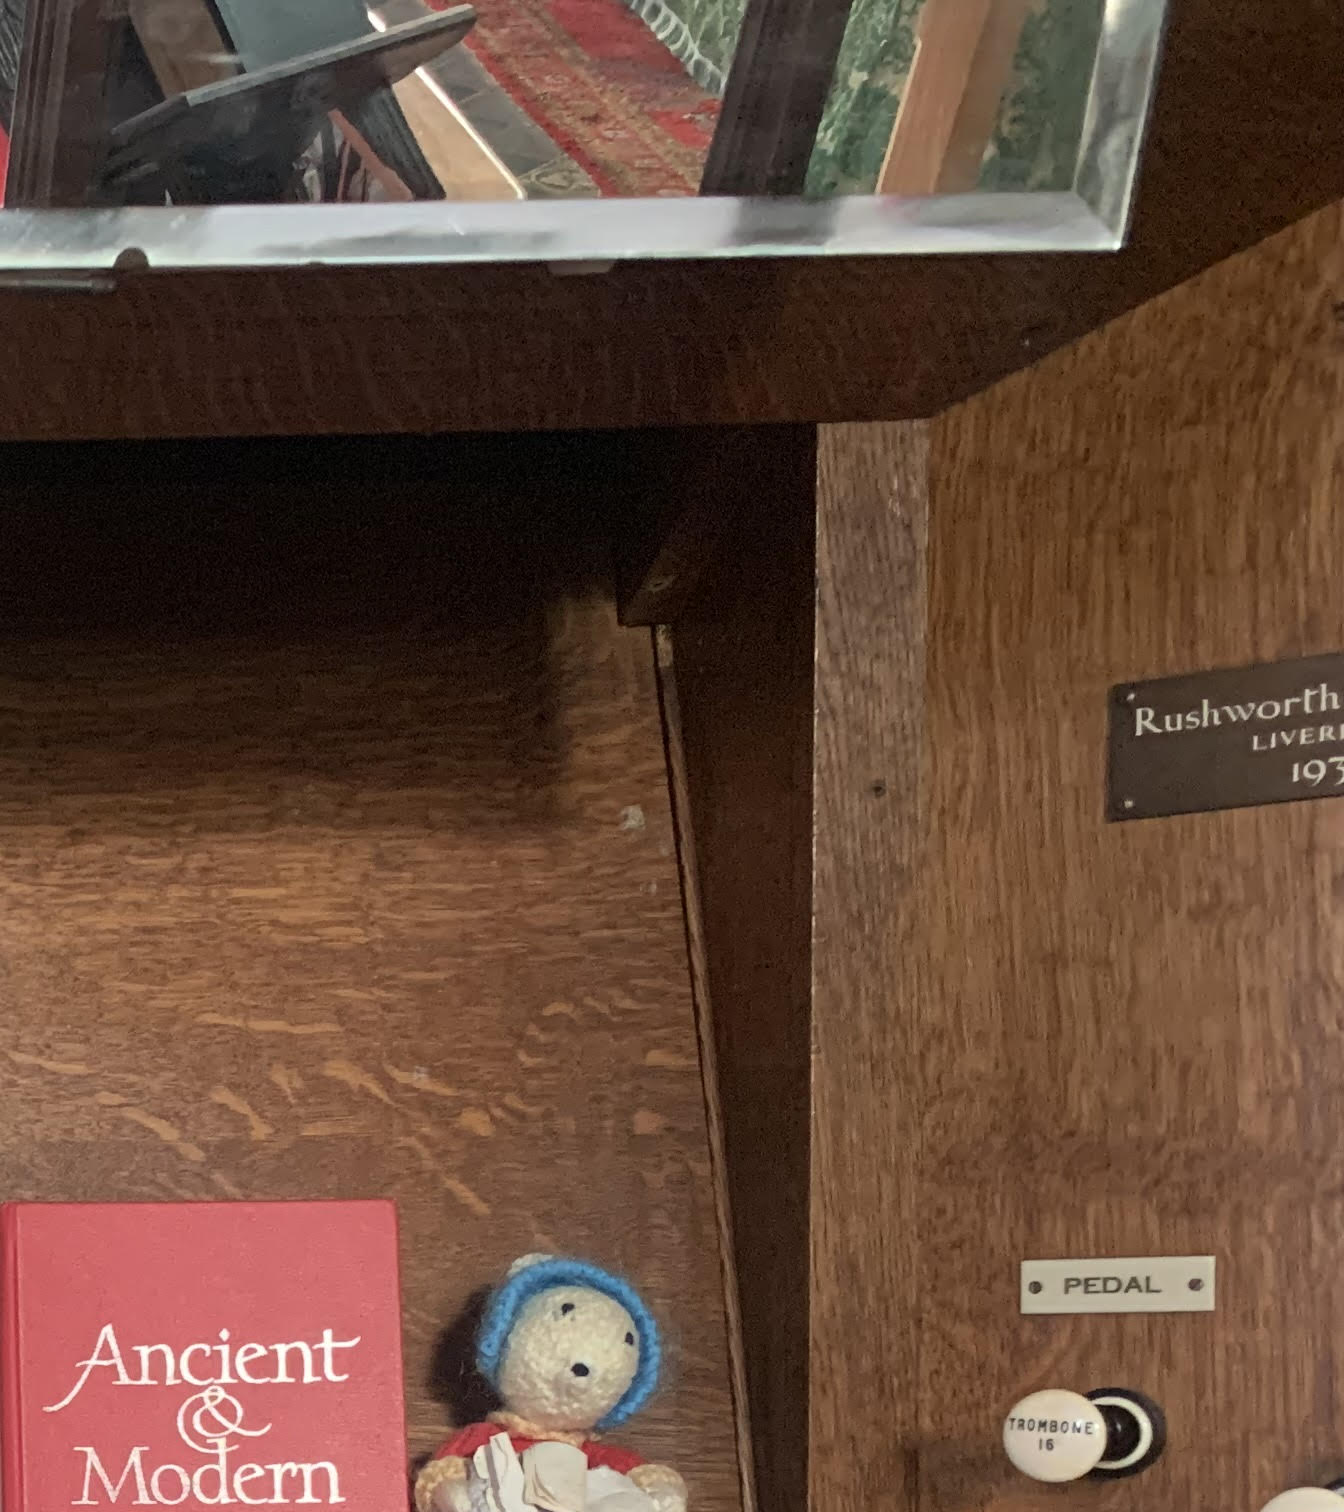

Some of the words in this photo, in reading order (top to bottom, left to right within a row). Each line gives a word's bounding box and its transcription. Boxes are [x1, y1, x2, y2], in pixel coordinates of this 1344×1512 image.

[1135, 683, 1341, 737] Rushworth
[1252, 724, 1344, 751] LIVER
[1063, 1275, 1162, 1295] PEDAL
[42, 1323, 362, 1413] Ancient
[176, 1385, 273, 1454] &
[1008, 1417, 1094, 1436] TROMBONE
[1038, 1438, 1055, 1452] 16
[71, 1437, 347, 1507] Modern
